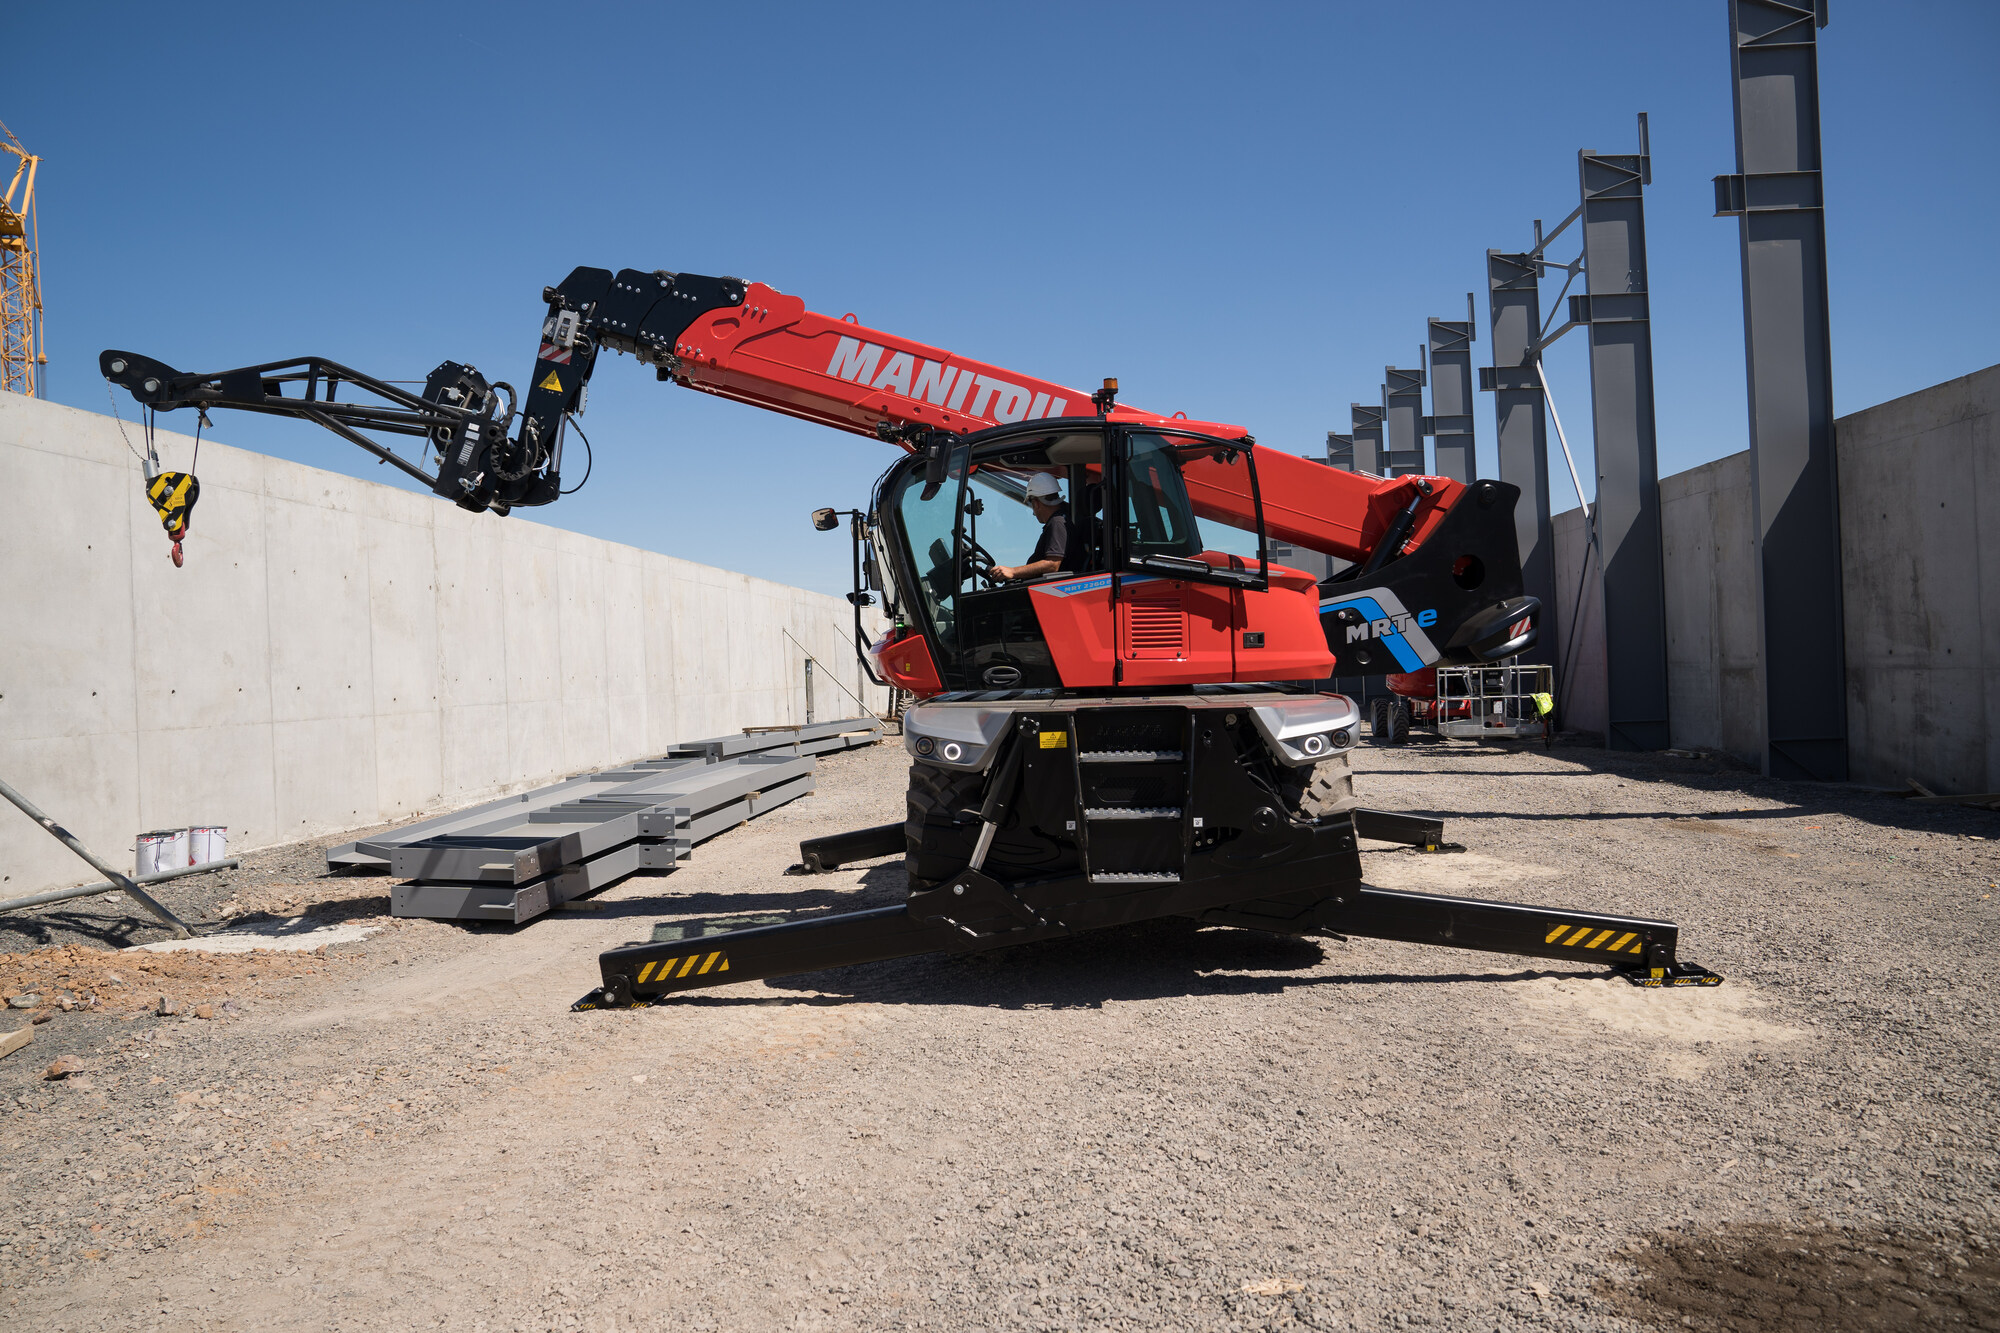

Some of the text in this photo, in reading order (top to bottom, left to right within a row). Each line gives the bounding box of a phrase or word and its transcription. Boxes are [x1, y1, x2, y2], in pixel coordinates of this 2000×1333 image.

[1083, 580, 1105, 589] 2260
[1346, 608, 1438, 644] MRT e
